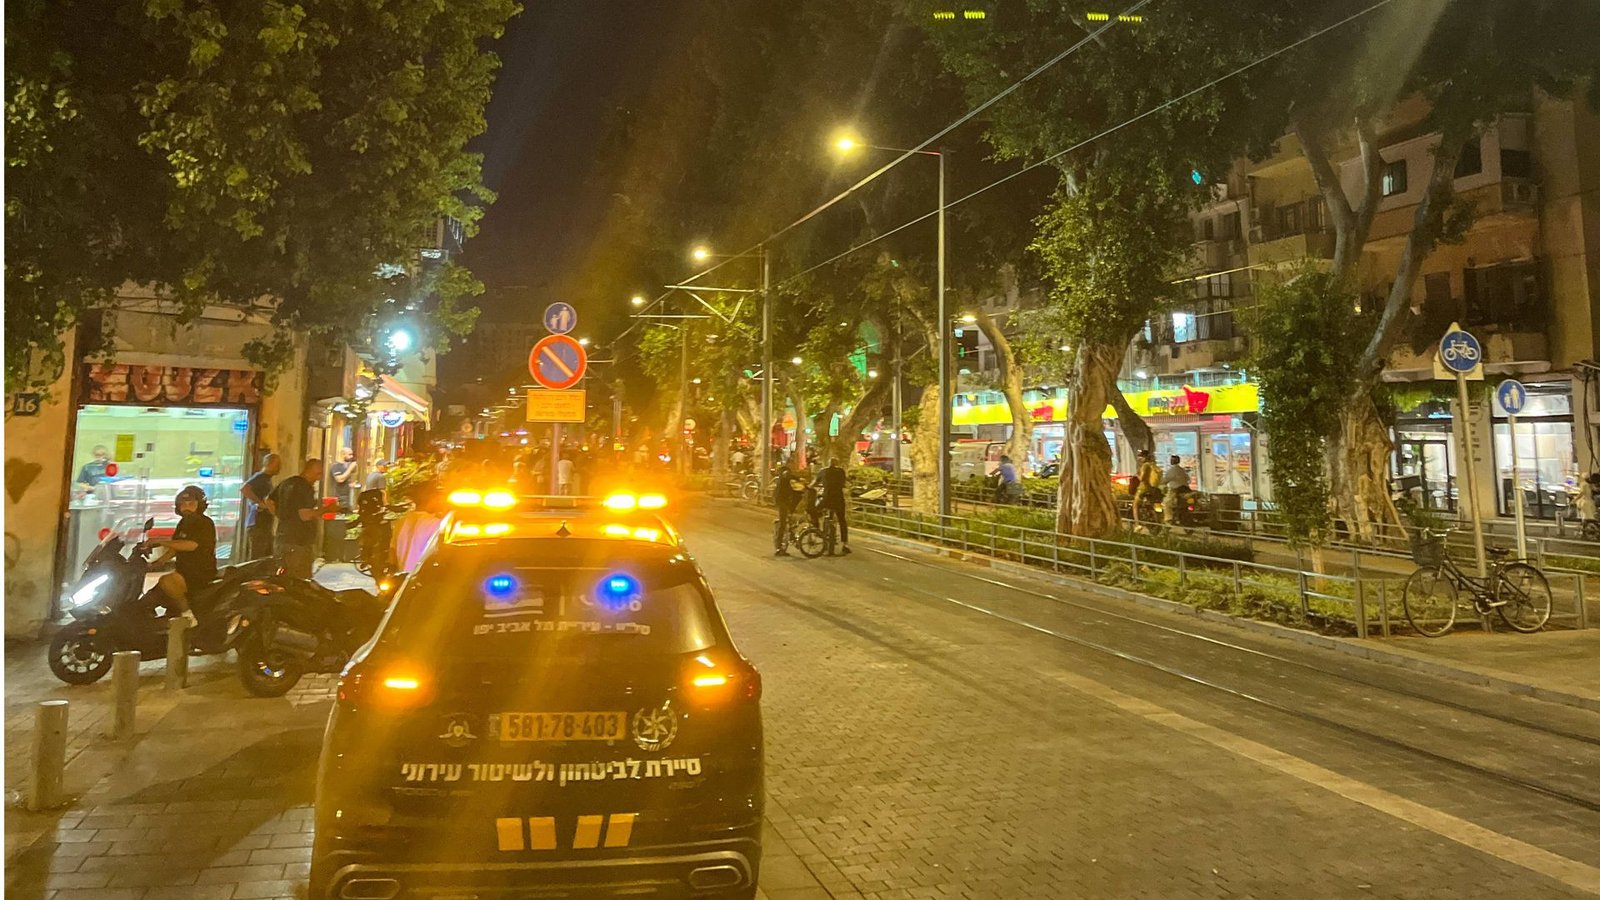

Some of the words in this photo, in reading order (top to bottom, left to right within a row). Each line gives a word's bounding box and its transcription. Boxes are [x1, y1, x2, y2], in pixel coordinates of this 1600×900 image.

[16, 398, 36, 412] 16
[473, 623, 494, 635] יפו
[496, 621, 531, 633] אביב
[534, 619, 554, 632] תל
[401, 763, 462, 781] עירוני
[467, 760, 555, 782] ולשיטור
[559, 757, 641, 787] לביטחון
[645, 758, 701, 777] סיירת
